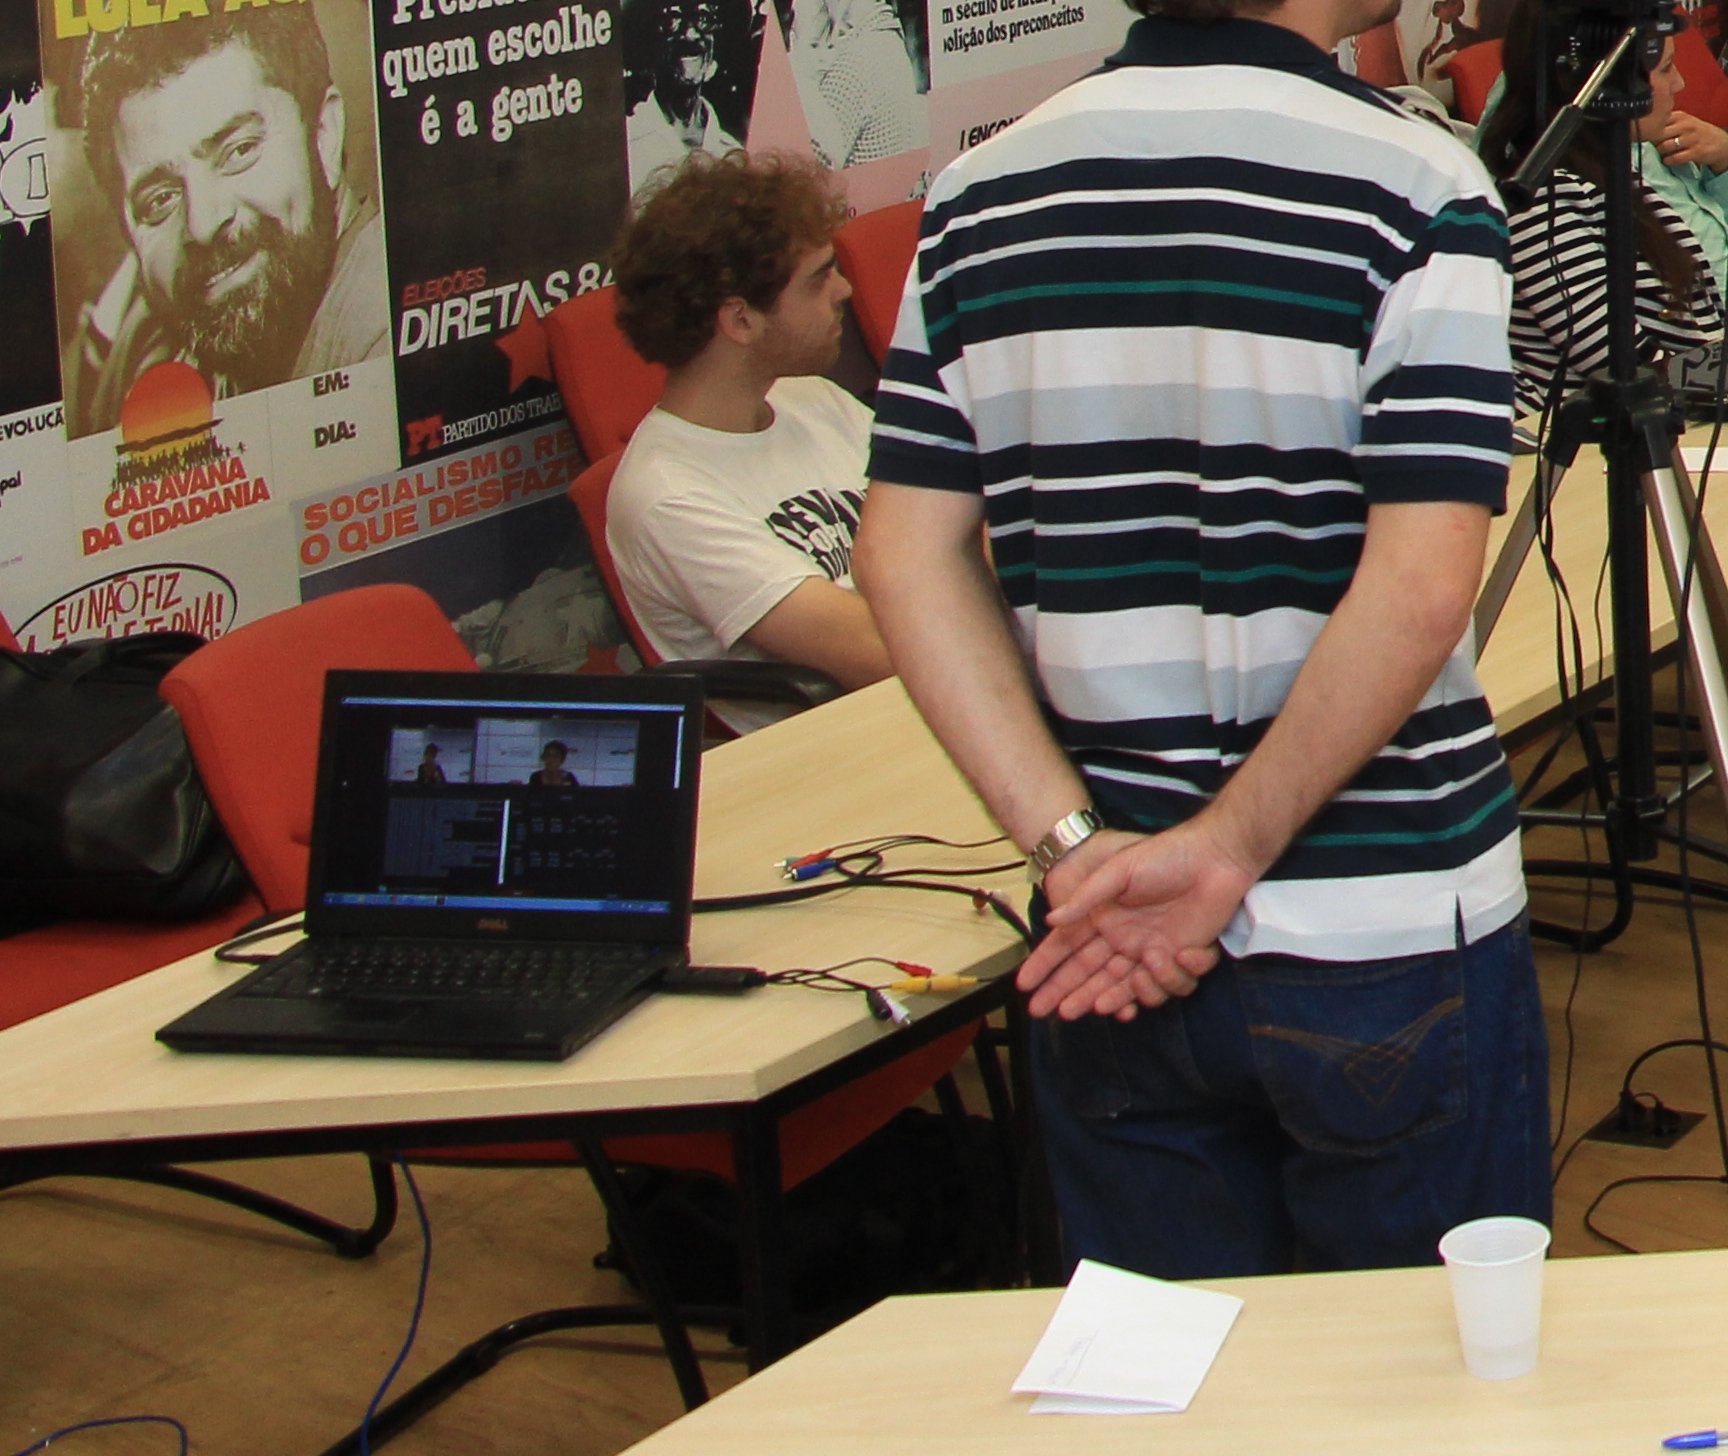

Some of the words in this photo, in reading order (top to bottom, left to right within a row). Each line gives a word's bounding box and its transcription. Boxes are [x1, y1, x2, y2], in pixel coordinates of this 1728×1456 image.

[382, 35, 479, 98] quem
[488, 4, 612, 65] escolhe
[421, 95, 441, 145] é
[457, 99, 478, 138] a
[491, 73, 584, 142] gente
[314, 372, 351, 398] EM:
[315, 420, 357, 449] DIA:
[406, 414, 443, 456] PT
[443, 411, 497, 444] PARTIDO
[499, 402, 525, 430] DOS
[82, 521, 123, 556] DA
[128, 477, 271, 540] CIDADANIA
[105, 457, 247, 518] CARAVANA
[303, 444, 522, 530] SOCIALISMO
[301, 534, 331, 566] O
[338, 504, 420, 554] QUE
[53, 600, 84, 640] EU
[87, 574, 140, 630] NÃO
[141, 573, 182, 617] FIZ
